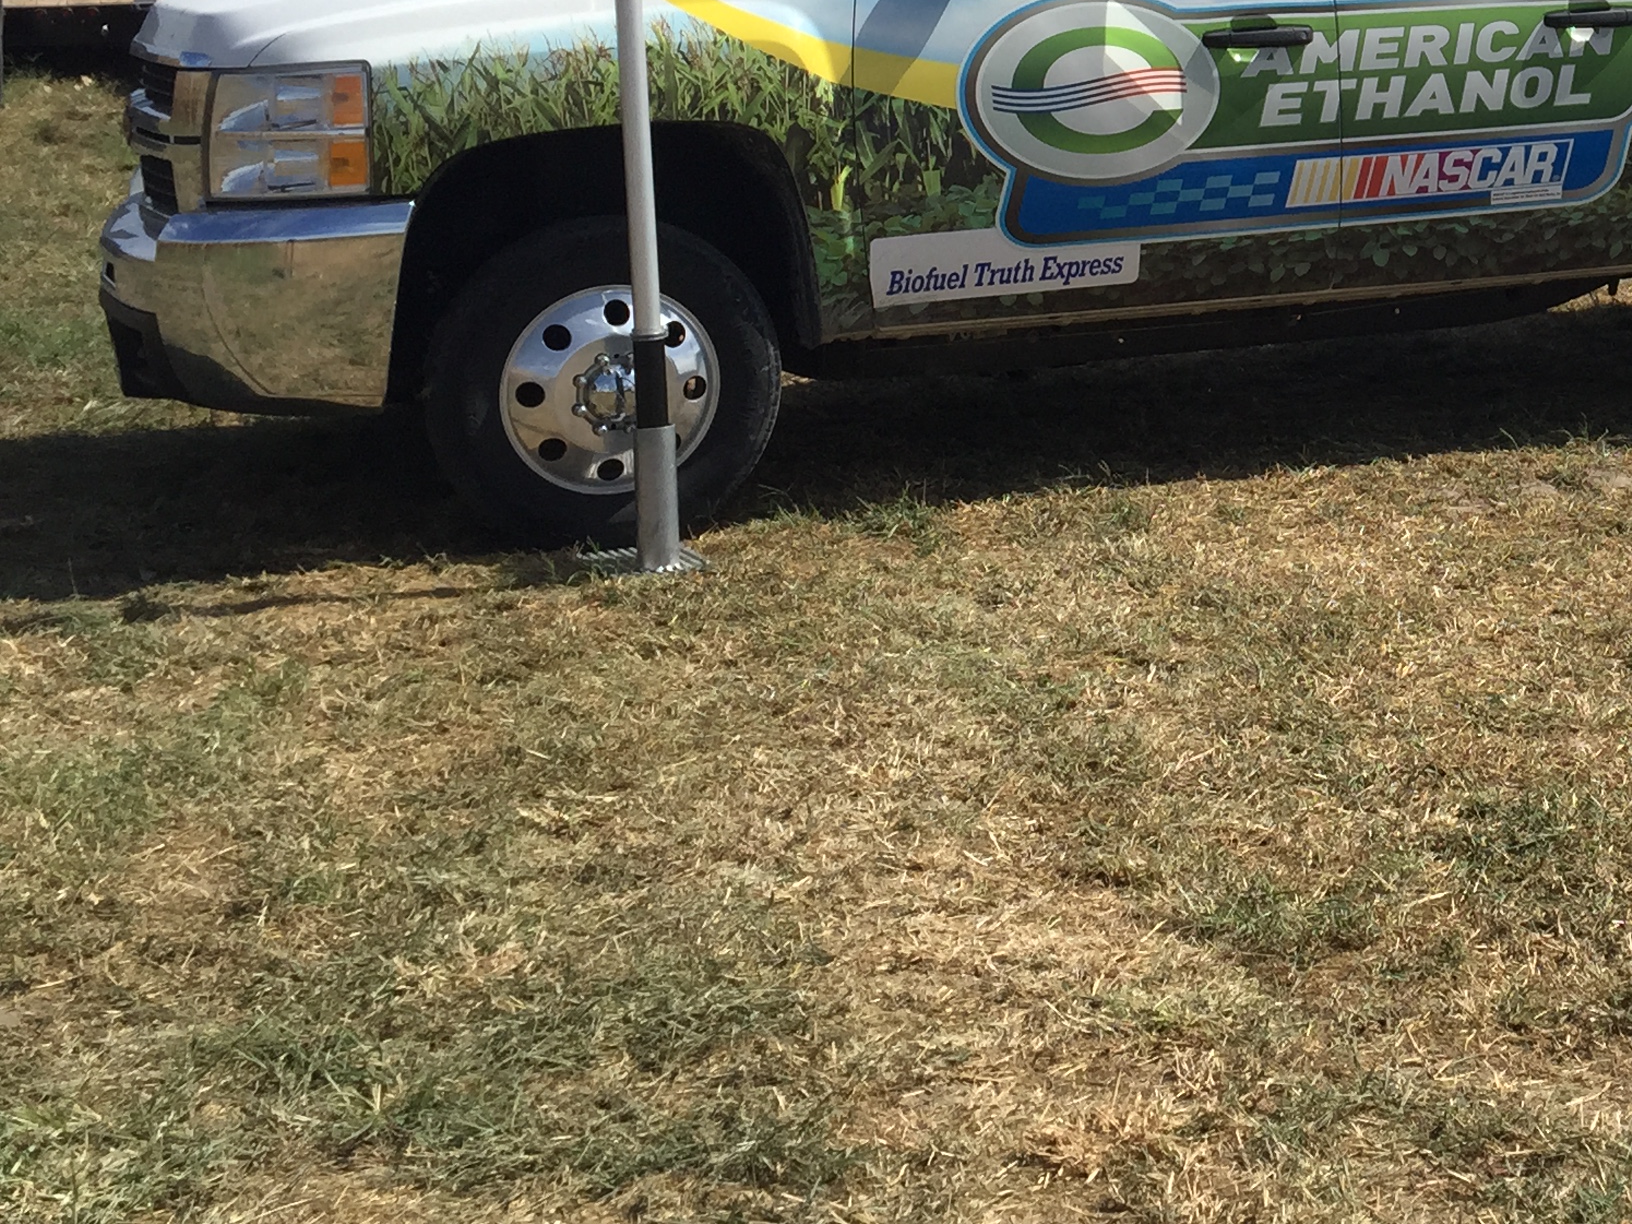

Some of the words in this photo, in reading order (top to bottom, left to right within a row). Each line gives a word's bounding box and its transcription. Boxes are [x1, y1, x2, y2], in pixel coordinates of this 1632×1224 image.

[1240, 19, 1616, 79] AMERICAN
[1257, 63, 1592, 128] ETHANOL
[1378, 141, 1558, 197] NASCAR
[886, 263, 969, 296] Biofuel
[974, 257, 1035, 288] Truth
[1038, 254, 1125, 286] Express
